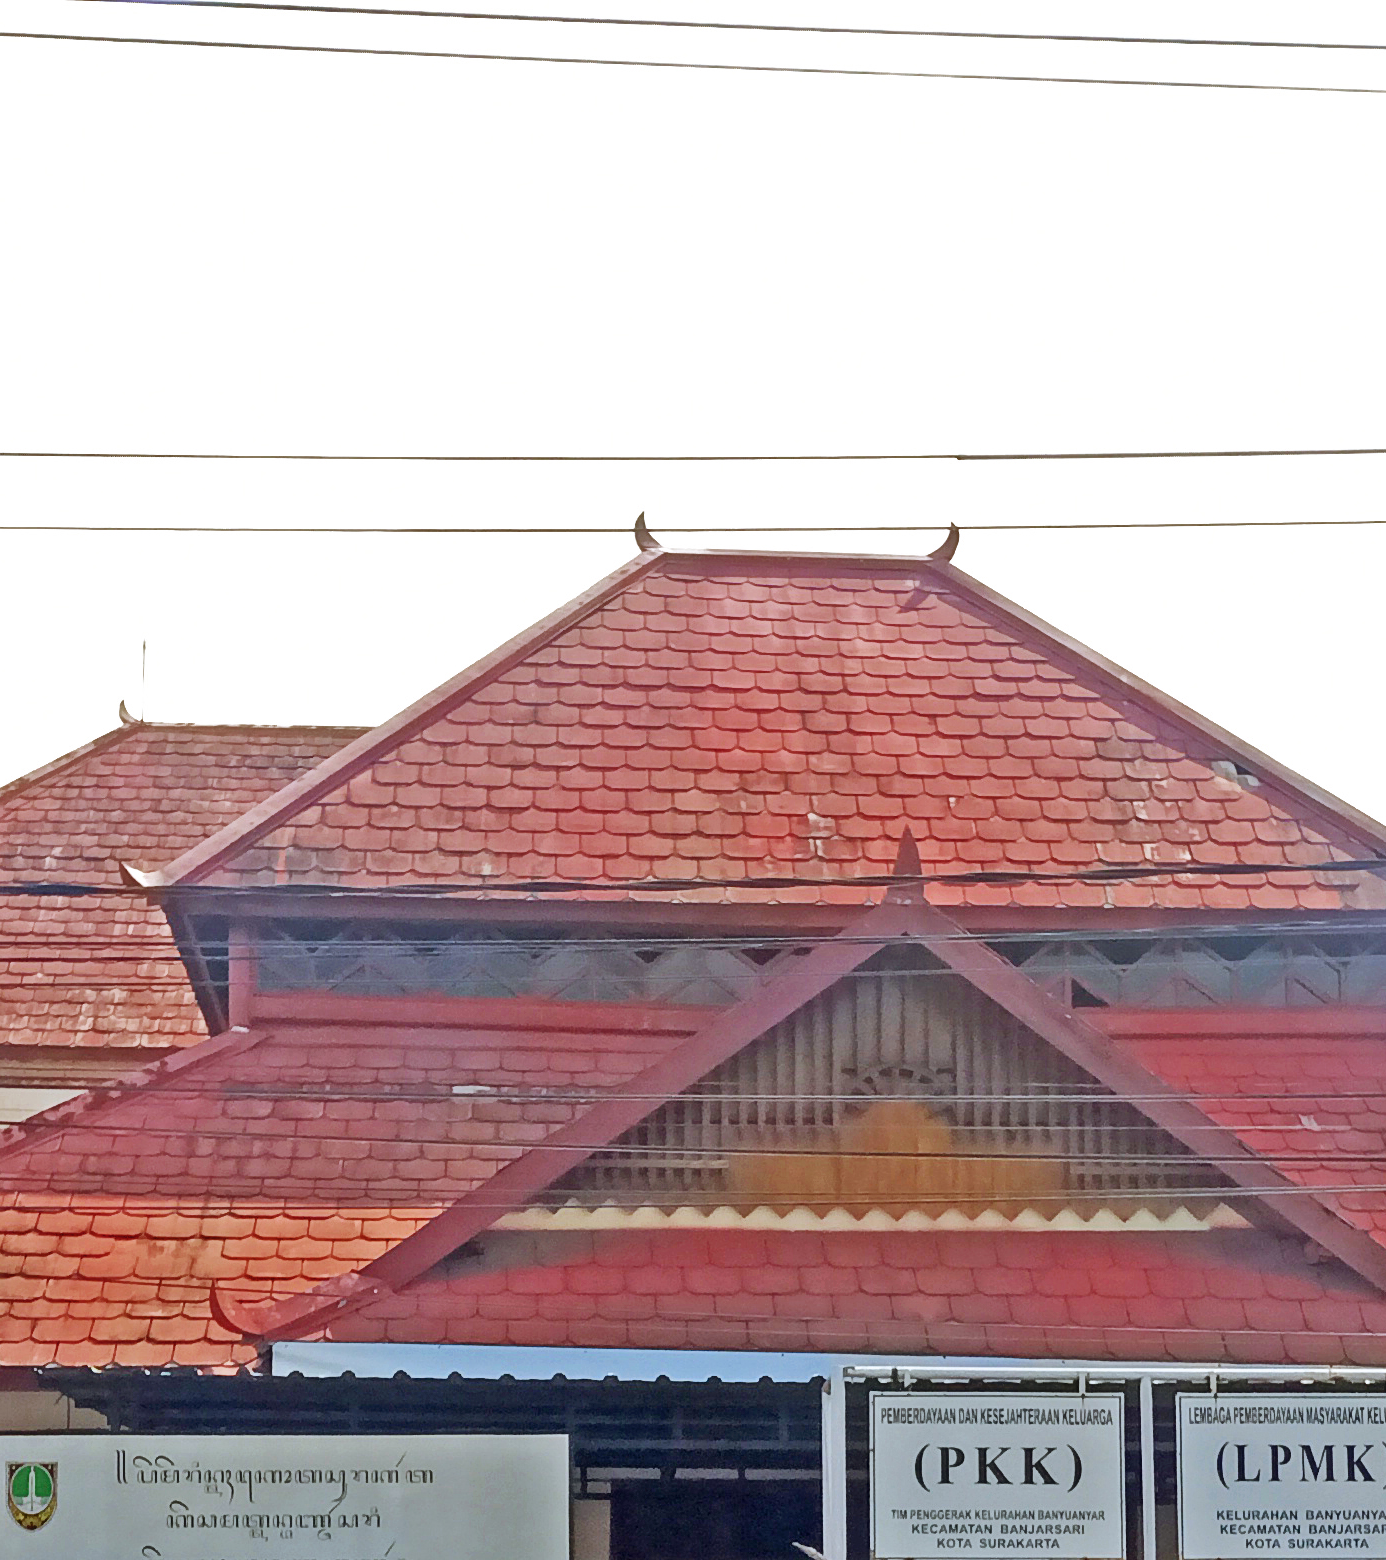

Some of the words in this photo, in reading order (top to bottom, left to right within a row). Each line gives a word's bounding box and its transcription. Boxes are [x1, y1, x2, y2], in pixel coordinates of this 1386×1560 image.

[880, 1407, 957, 1425] PEMBERDAYAAN
[958, 1407, 978, 1425] DAN
[979, 1407, 1060, 1426] KESEJAHTERAAN
[1061, 1408, 1114, 1426] KELUARGA
[1188, 1406, 1233, 1425] LEMBAGA
[1233, 1406, 1305, 1425] PEMBERDAYAAN
[1305, 1406, 1365, 1425] MASYARAKAT
[914, 1443, 1083, 1493] (PKK)
[890, 1509, 908, 1520] TIM
[909, 1509, 972, 1521] PENGGERAK
[974, 1509, 1036, 1521] KELURAHAN
[1037, 1509, 1106, 1521] BANYUANYAR
[1216, 1509, 1298, 1521] KELURAHAN
[911, 1523, 993, 1535] KECAMATAN
[1000, 1523, 1085, 1535] BANJARSARI
[1219, 1523, 1301, 1535] KECAMATAN
[936, 1537, 973, 1549] KOTA
[979, 1537, 1061, 1549] SURAKARTA
[1245, 1538, 1281, 1550] KOTA
[1287, 1537, 1370, 1550] SURAKARTA
